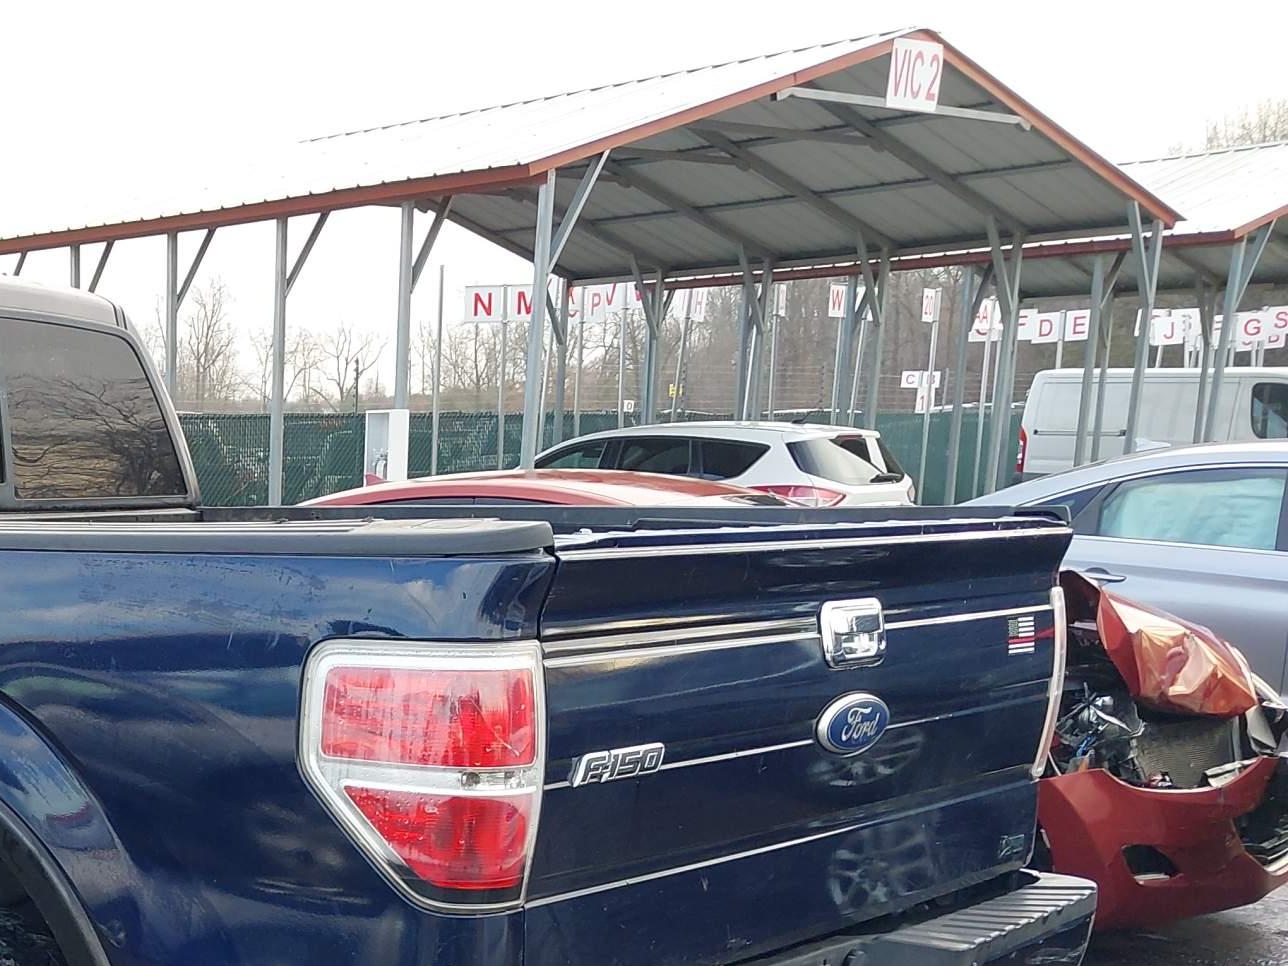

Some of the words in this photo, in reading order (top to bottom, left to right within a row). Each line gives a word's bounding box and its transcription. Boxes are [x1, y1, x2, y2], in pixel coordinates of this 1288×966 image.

[893, 48, 925, 100] VIC
[925, 53, 941, 102] 2
[473, 292, 492, 317] N
[591, 292, 601, 317] P
[831, 289, 844, 312] W
[1038, 318, 1054, 338] D
[1072, 315, 1087, 335] E
[1243, 318, 1262, 336] G
[1274, 311, 1288, 329] S
[1163, 322, 1175, 340] J
[905, 374, 915, 385] C
[841, 706, 882, 742] Ford
[579, 744, 665, 787] F-150
